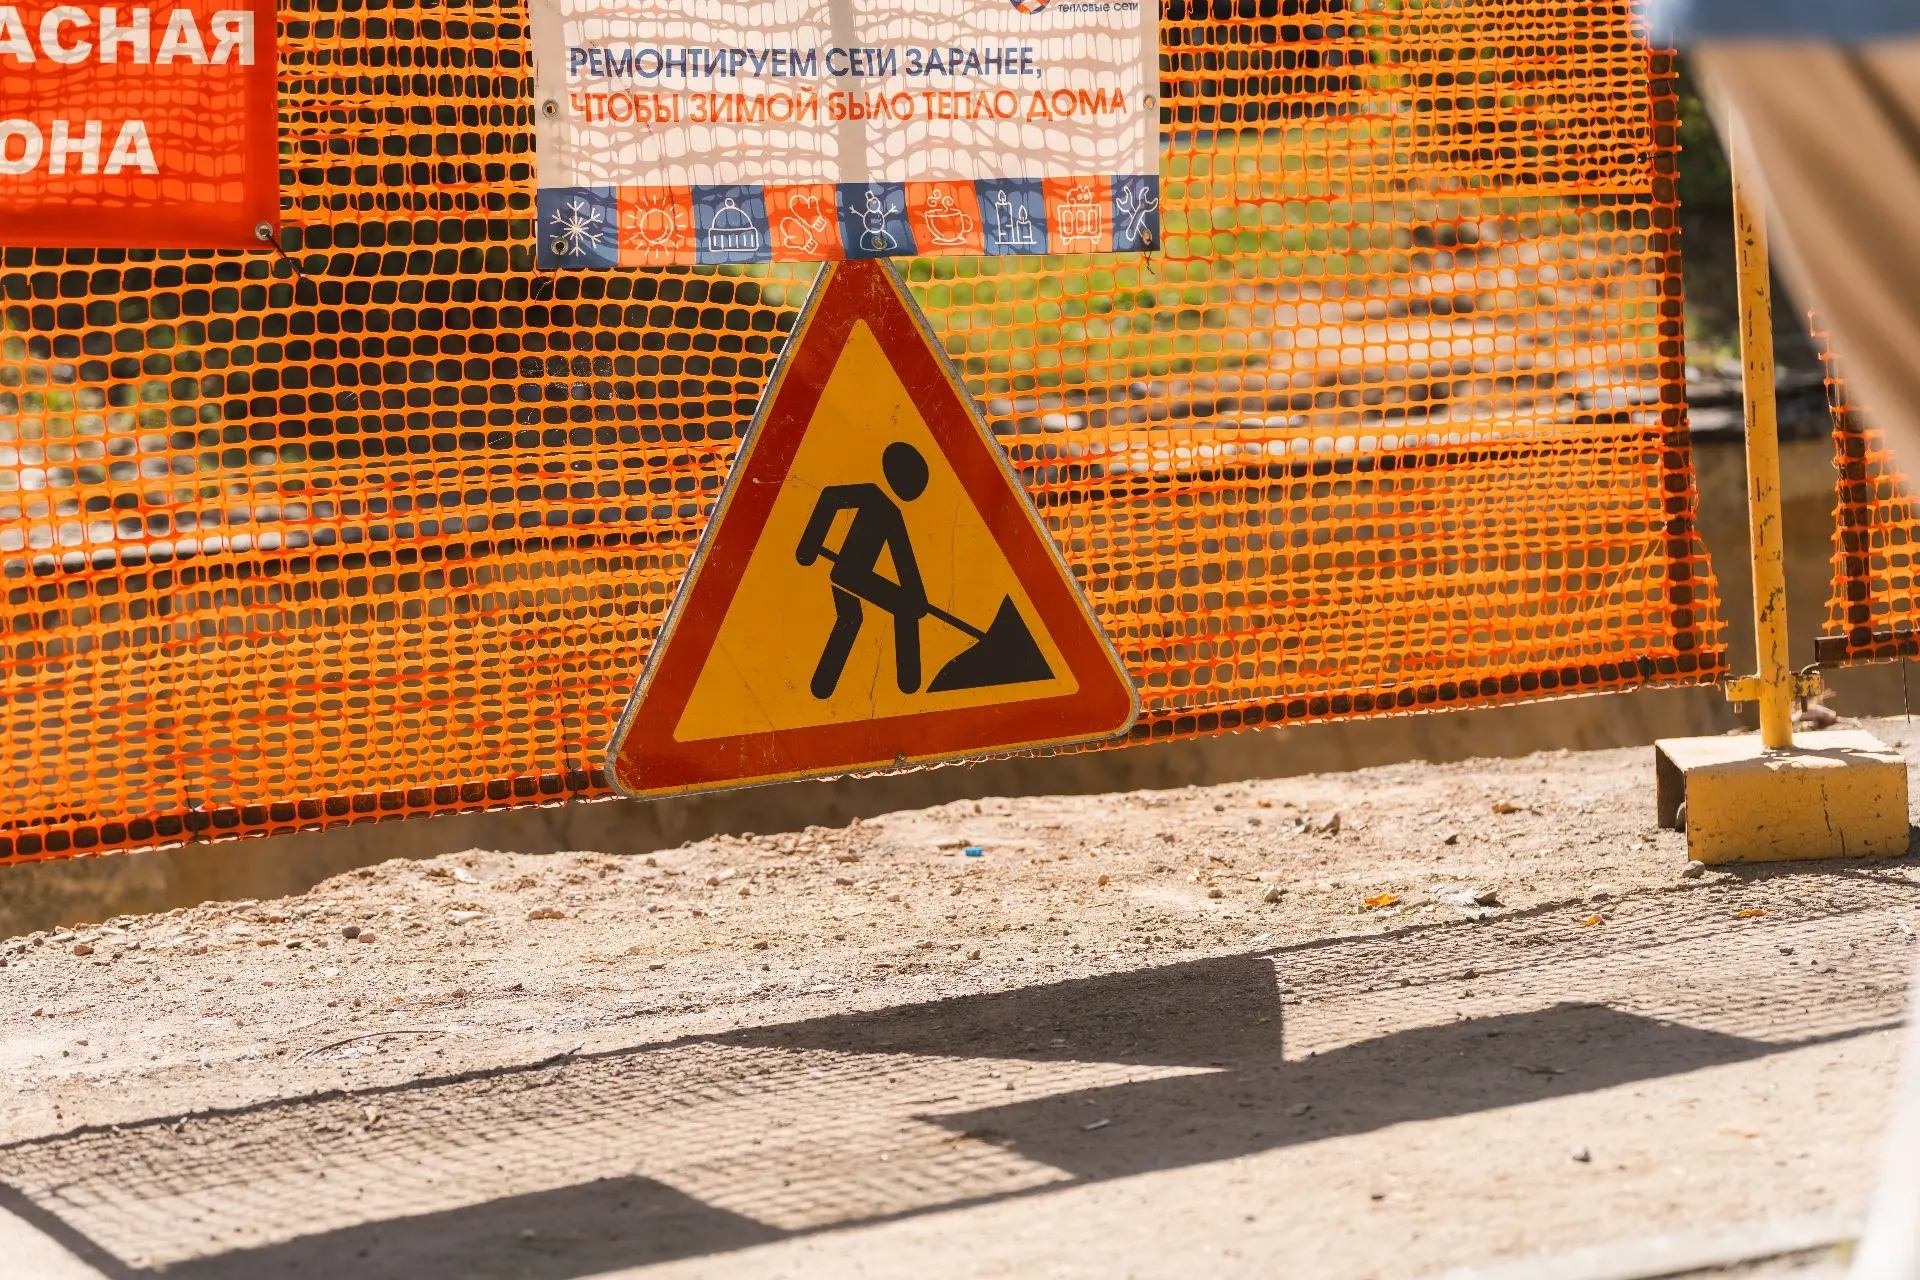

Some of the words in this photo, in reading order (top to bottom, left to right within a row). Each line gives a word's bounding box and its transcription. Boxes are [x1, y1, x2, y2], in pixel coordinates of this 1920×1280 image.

[1058, 3, 1111, 13] тепловые
[1113, 2, 1139, 12] сети
[570, 47, 818, 79] РЕМОНТИРУЕМ
[825, 47, 897, 78] СЕТИ
[905, 46, 1043, 79] ЗАРАНЕЕ,
[570, 92, 680, 123] ЧТОБЫ
[689, 84, 818, 123] ЗИМОЙ
[828, 91, 915, 122] БЫЛО
[922, 89, 1019, 121] ТЕПЛО
[1026, 87, 1128, 123] ДОМА
